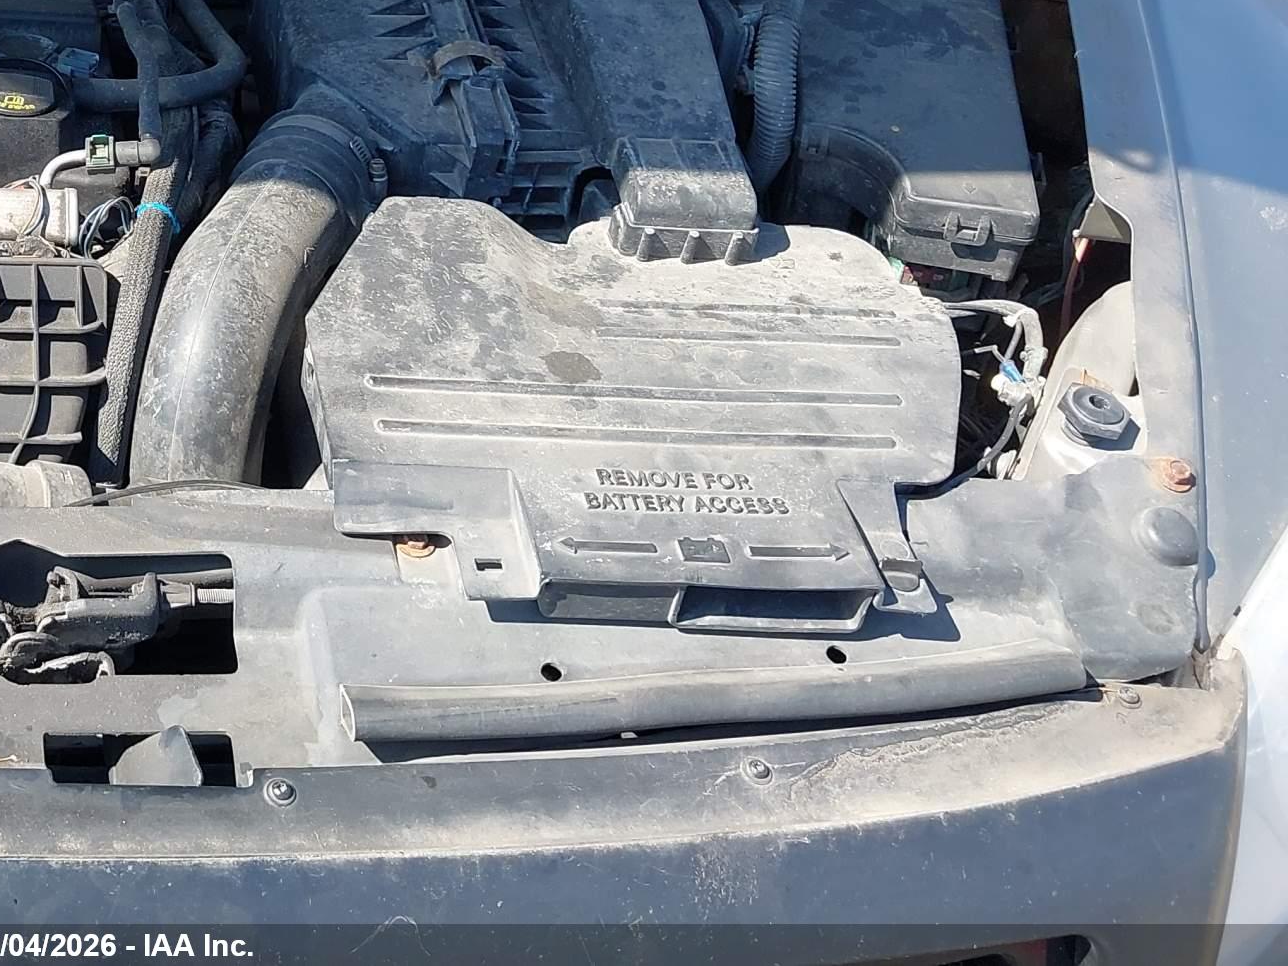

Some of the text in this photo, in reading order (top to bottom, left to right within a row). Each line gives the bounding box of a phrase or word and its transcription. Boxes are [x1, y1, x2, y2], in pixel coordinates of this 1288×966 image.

[596, 468, 753, 491] REMOVE FOR
[584, 492, 790, 515] BATTERY ACCESS
